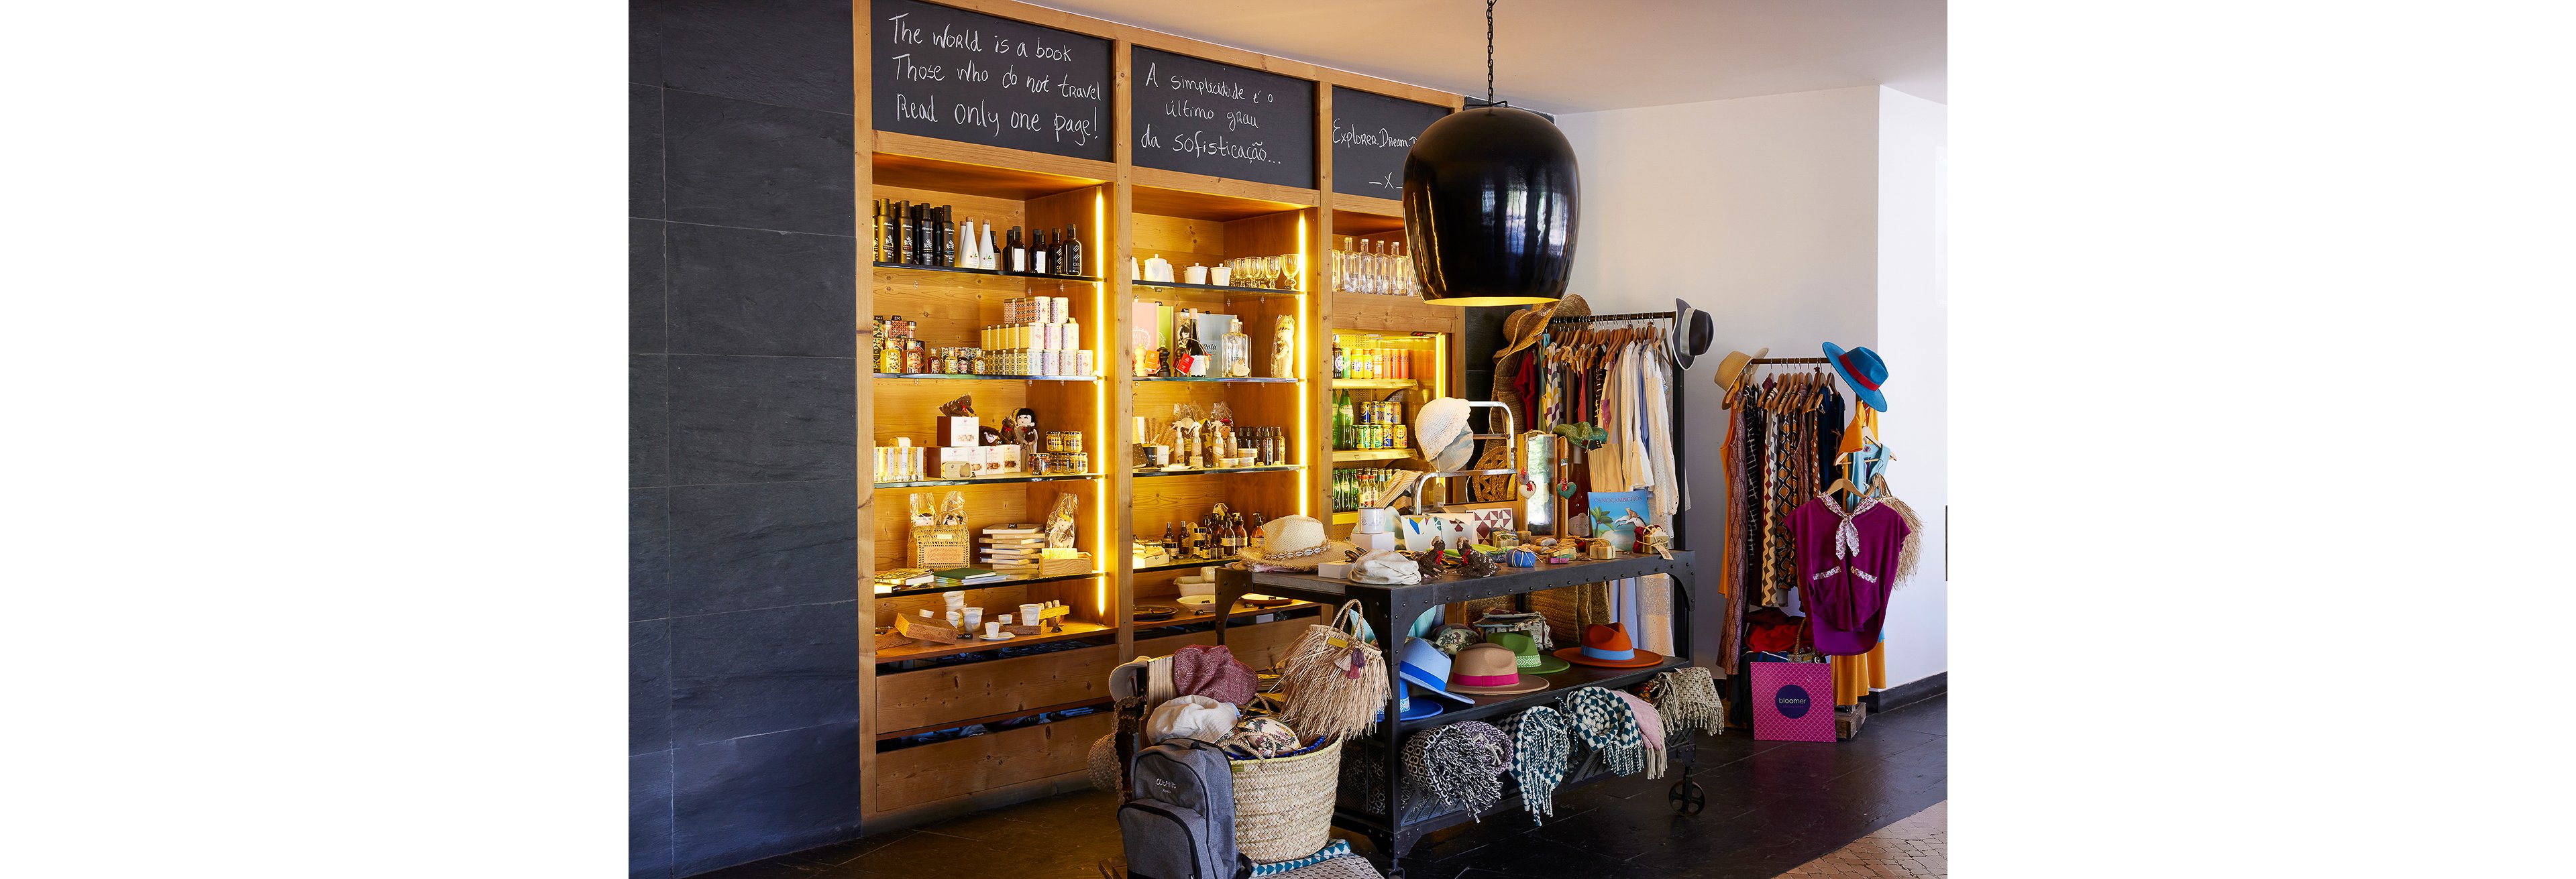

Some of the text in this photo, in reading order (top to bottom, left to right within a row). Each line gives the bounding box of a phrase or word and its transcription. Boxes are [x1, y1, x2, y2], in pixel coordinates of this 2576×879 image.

[889, 13, 922, 44] The
[994, 35, 1009, 53] is
[1017, 42, 1028, 58] a
[1035, 38, 1071, 62] book
[892, 54, 945, 81] Those
[1002, 64, 1018, 89] do
[1026, 75, 1050, 93] not
[1146, 62, 1159, 88] A
[897, 93, 938, 121] Read
[1011, 111, 1041, 131] one
[1054, 107, 1097, 145] page!
[1141, 123, 1161, 148] da
